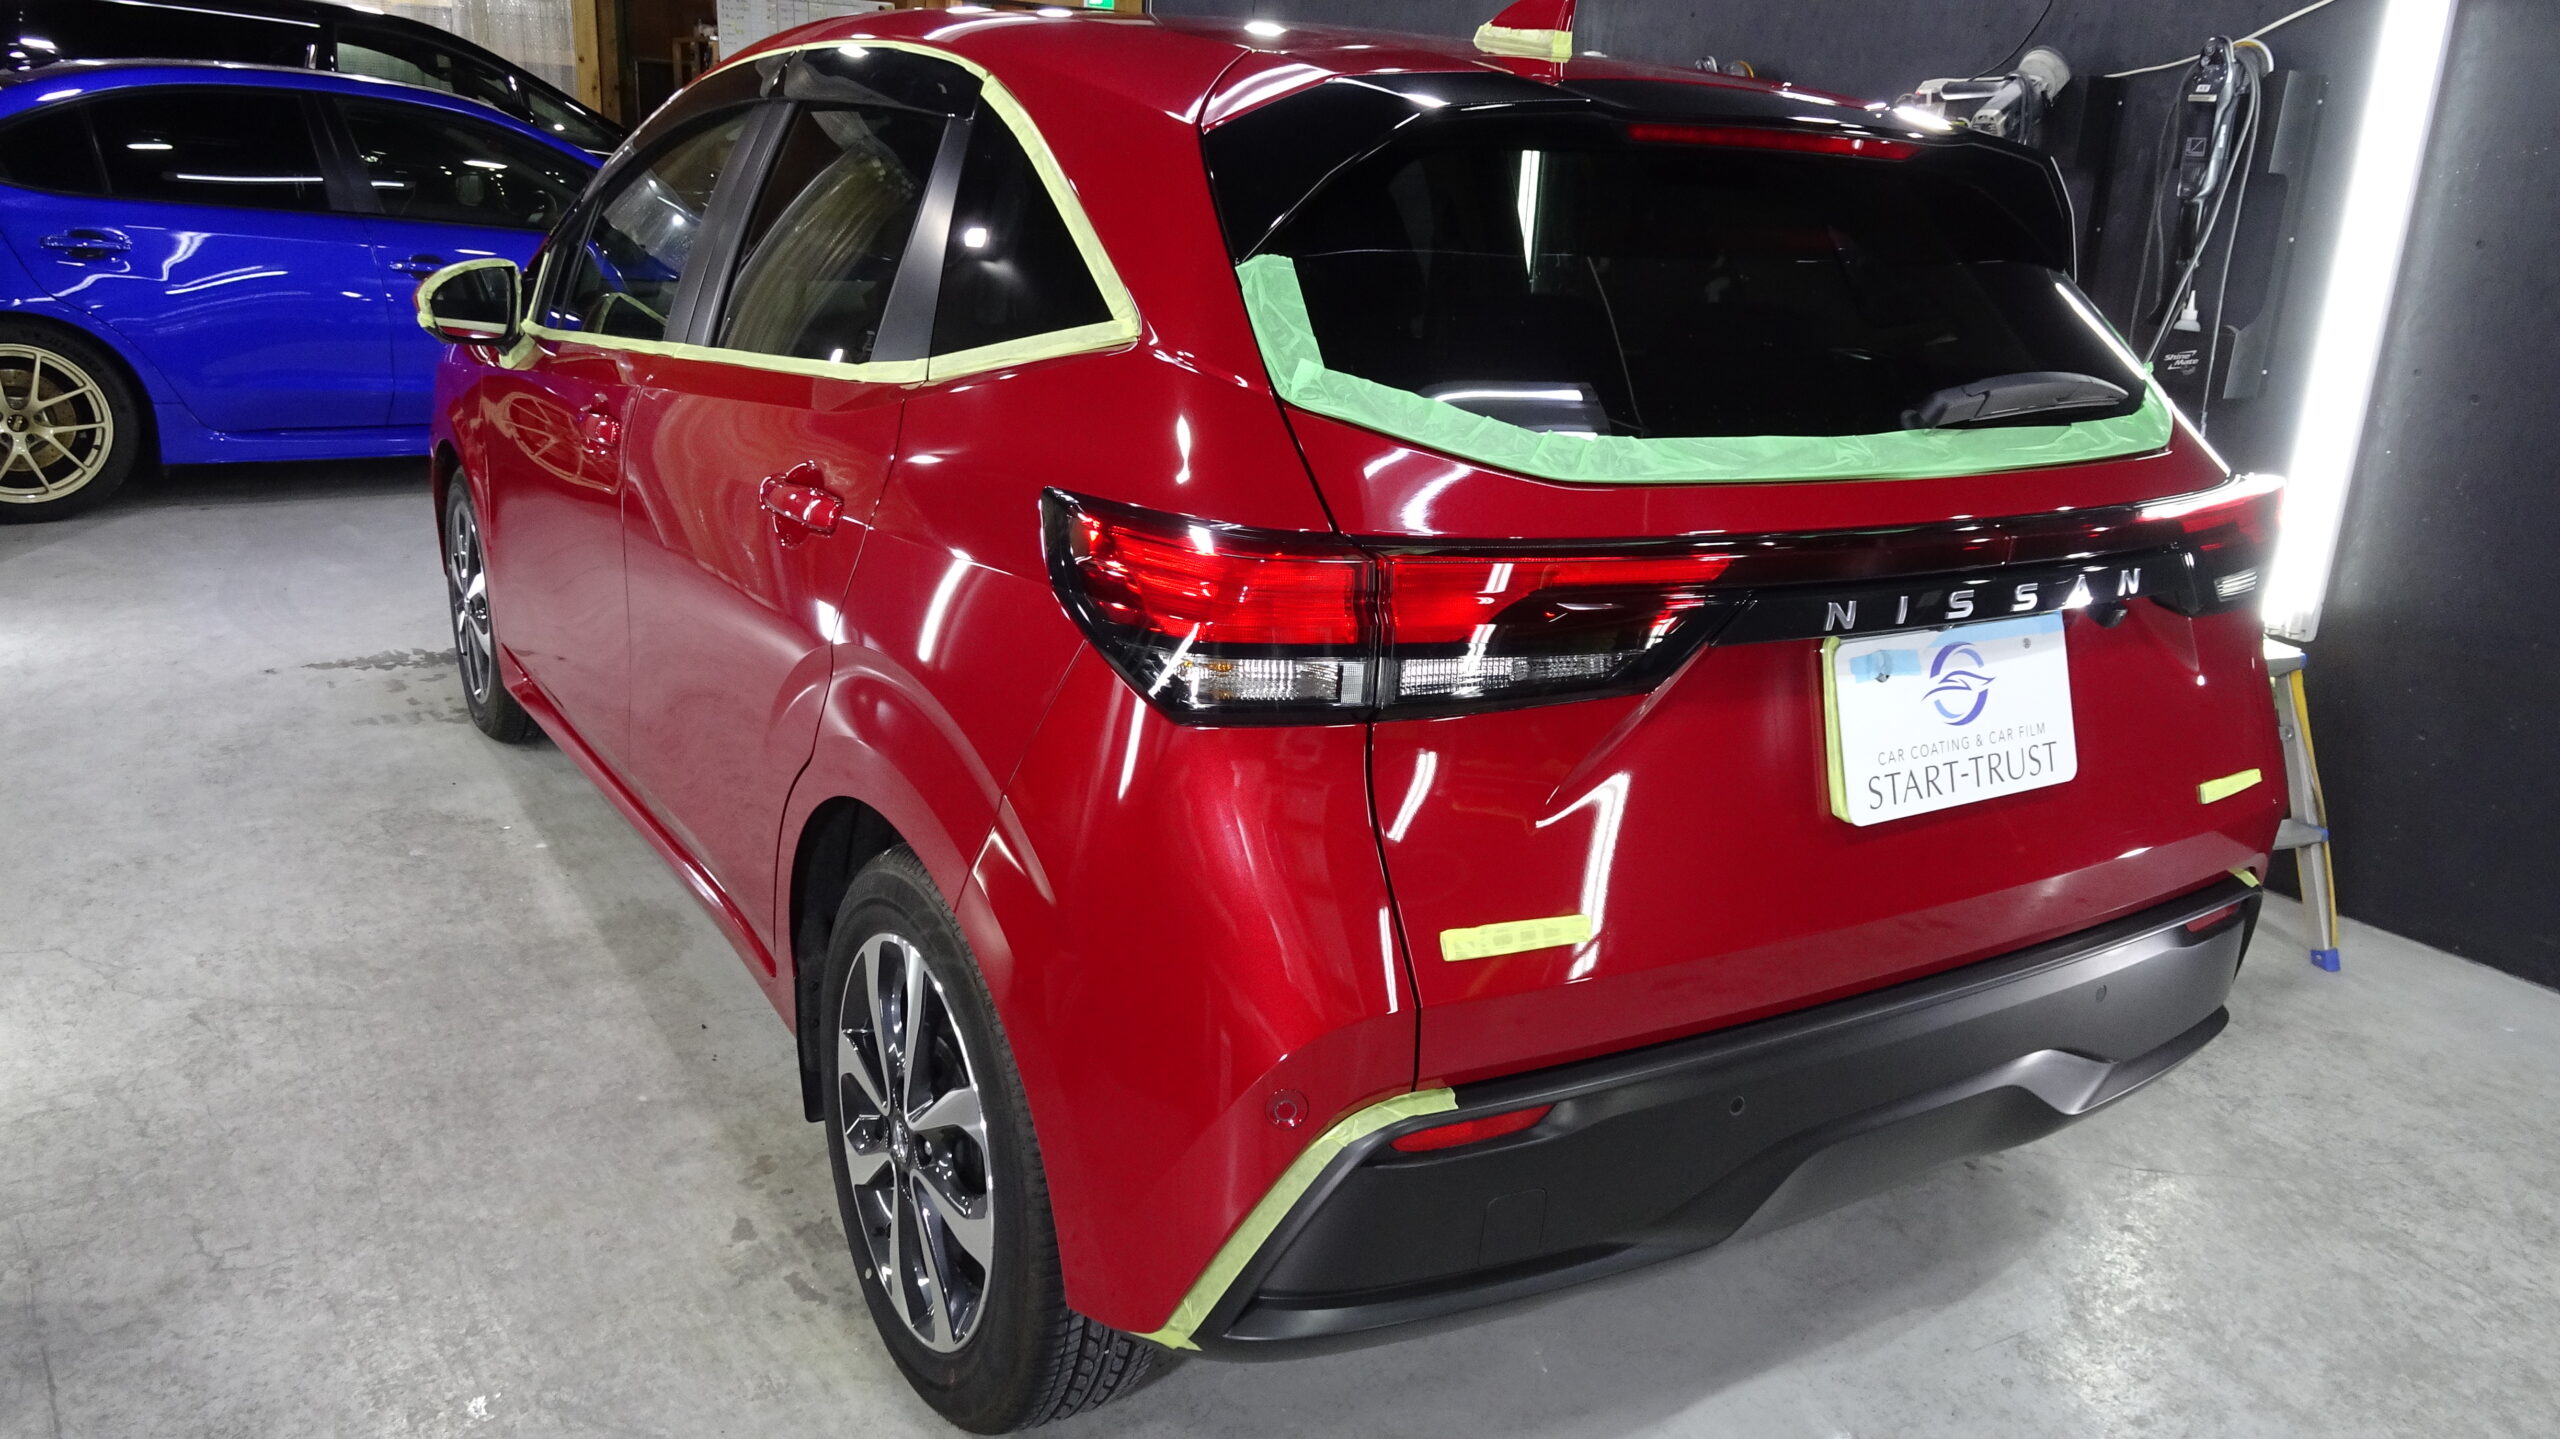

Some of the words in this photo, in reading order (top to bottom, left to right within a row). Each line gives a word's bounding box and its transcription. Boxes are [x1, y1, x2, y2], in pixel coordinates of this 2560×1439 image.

[1824, 567, 2141, 632] NISSAN
[1868, 741, 2057, 810] START-TRUST
[1877, 748, 1905, 766] CAR
[1910, 736, 1970, 760] COATING
[1975, 733, 1984, 747] &
[1989, 728, 2014, 744] CAR
[2018, 722, 2046, 738] FILM
